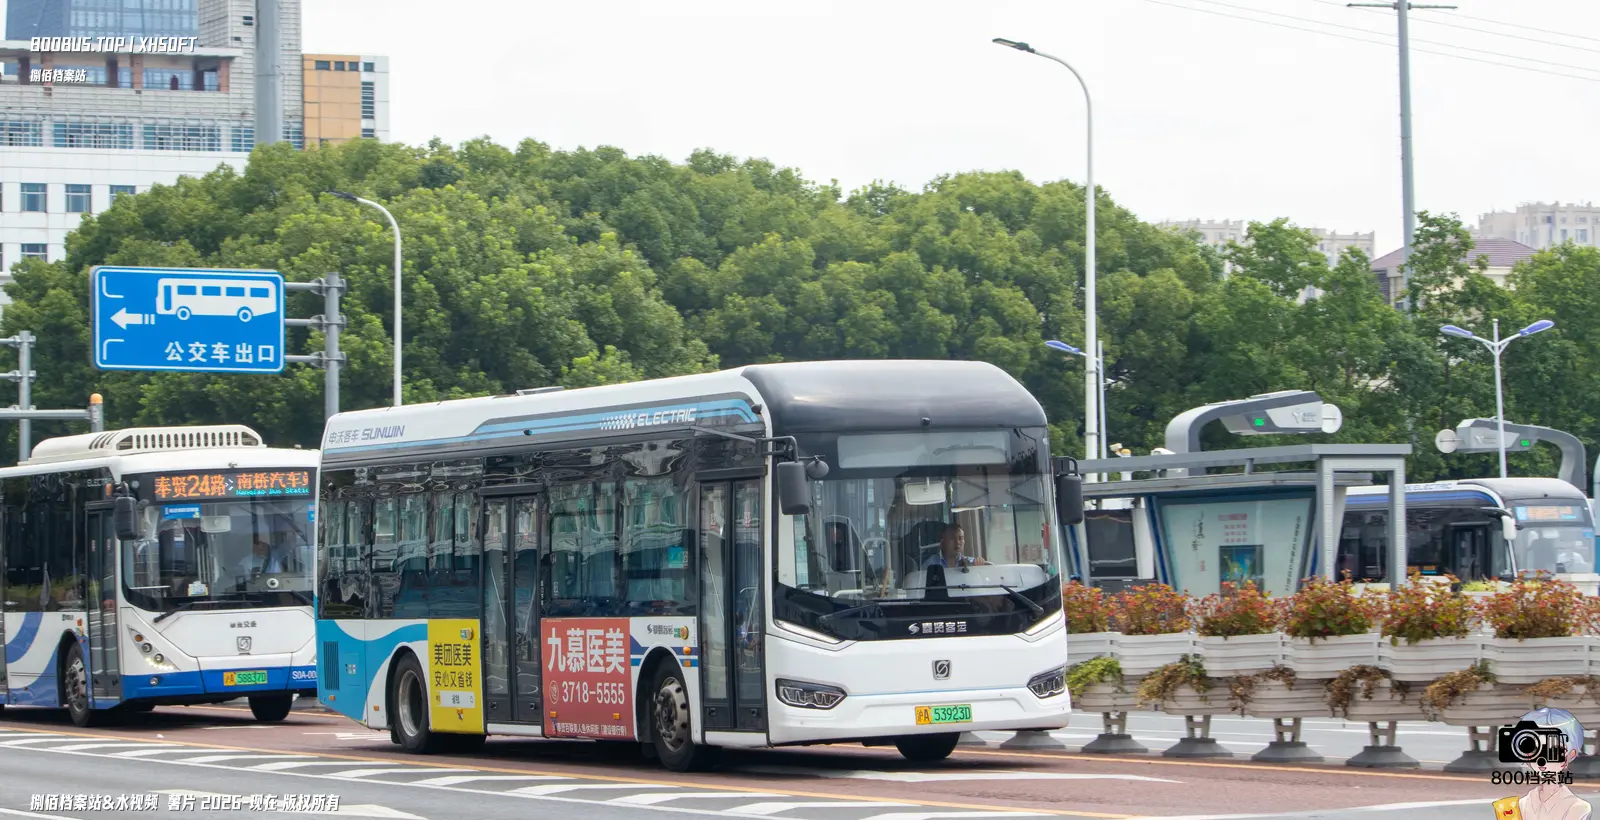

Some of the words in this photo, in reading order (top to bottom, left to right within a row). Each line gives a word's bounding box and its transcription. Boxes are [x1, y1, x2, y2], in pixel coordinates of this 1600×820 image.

[164, 340, 275, 364] 公交车出口
[637, 407, 697, 427] ELECTRIC
[361, 425, 405, 440] SUNWIN
[154, 473, 226, 498] 奉贤24路
[434, 643, 472, 666] 美团医美
[547, 627, 625, 674] 九慕医美
[434, 671, 473, 688] 安心又省钱
[562, 680, 625, 704] 3718-5555
